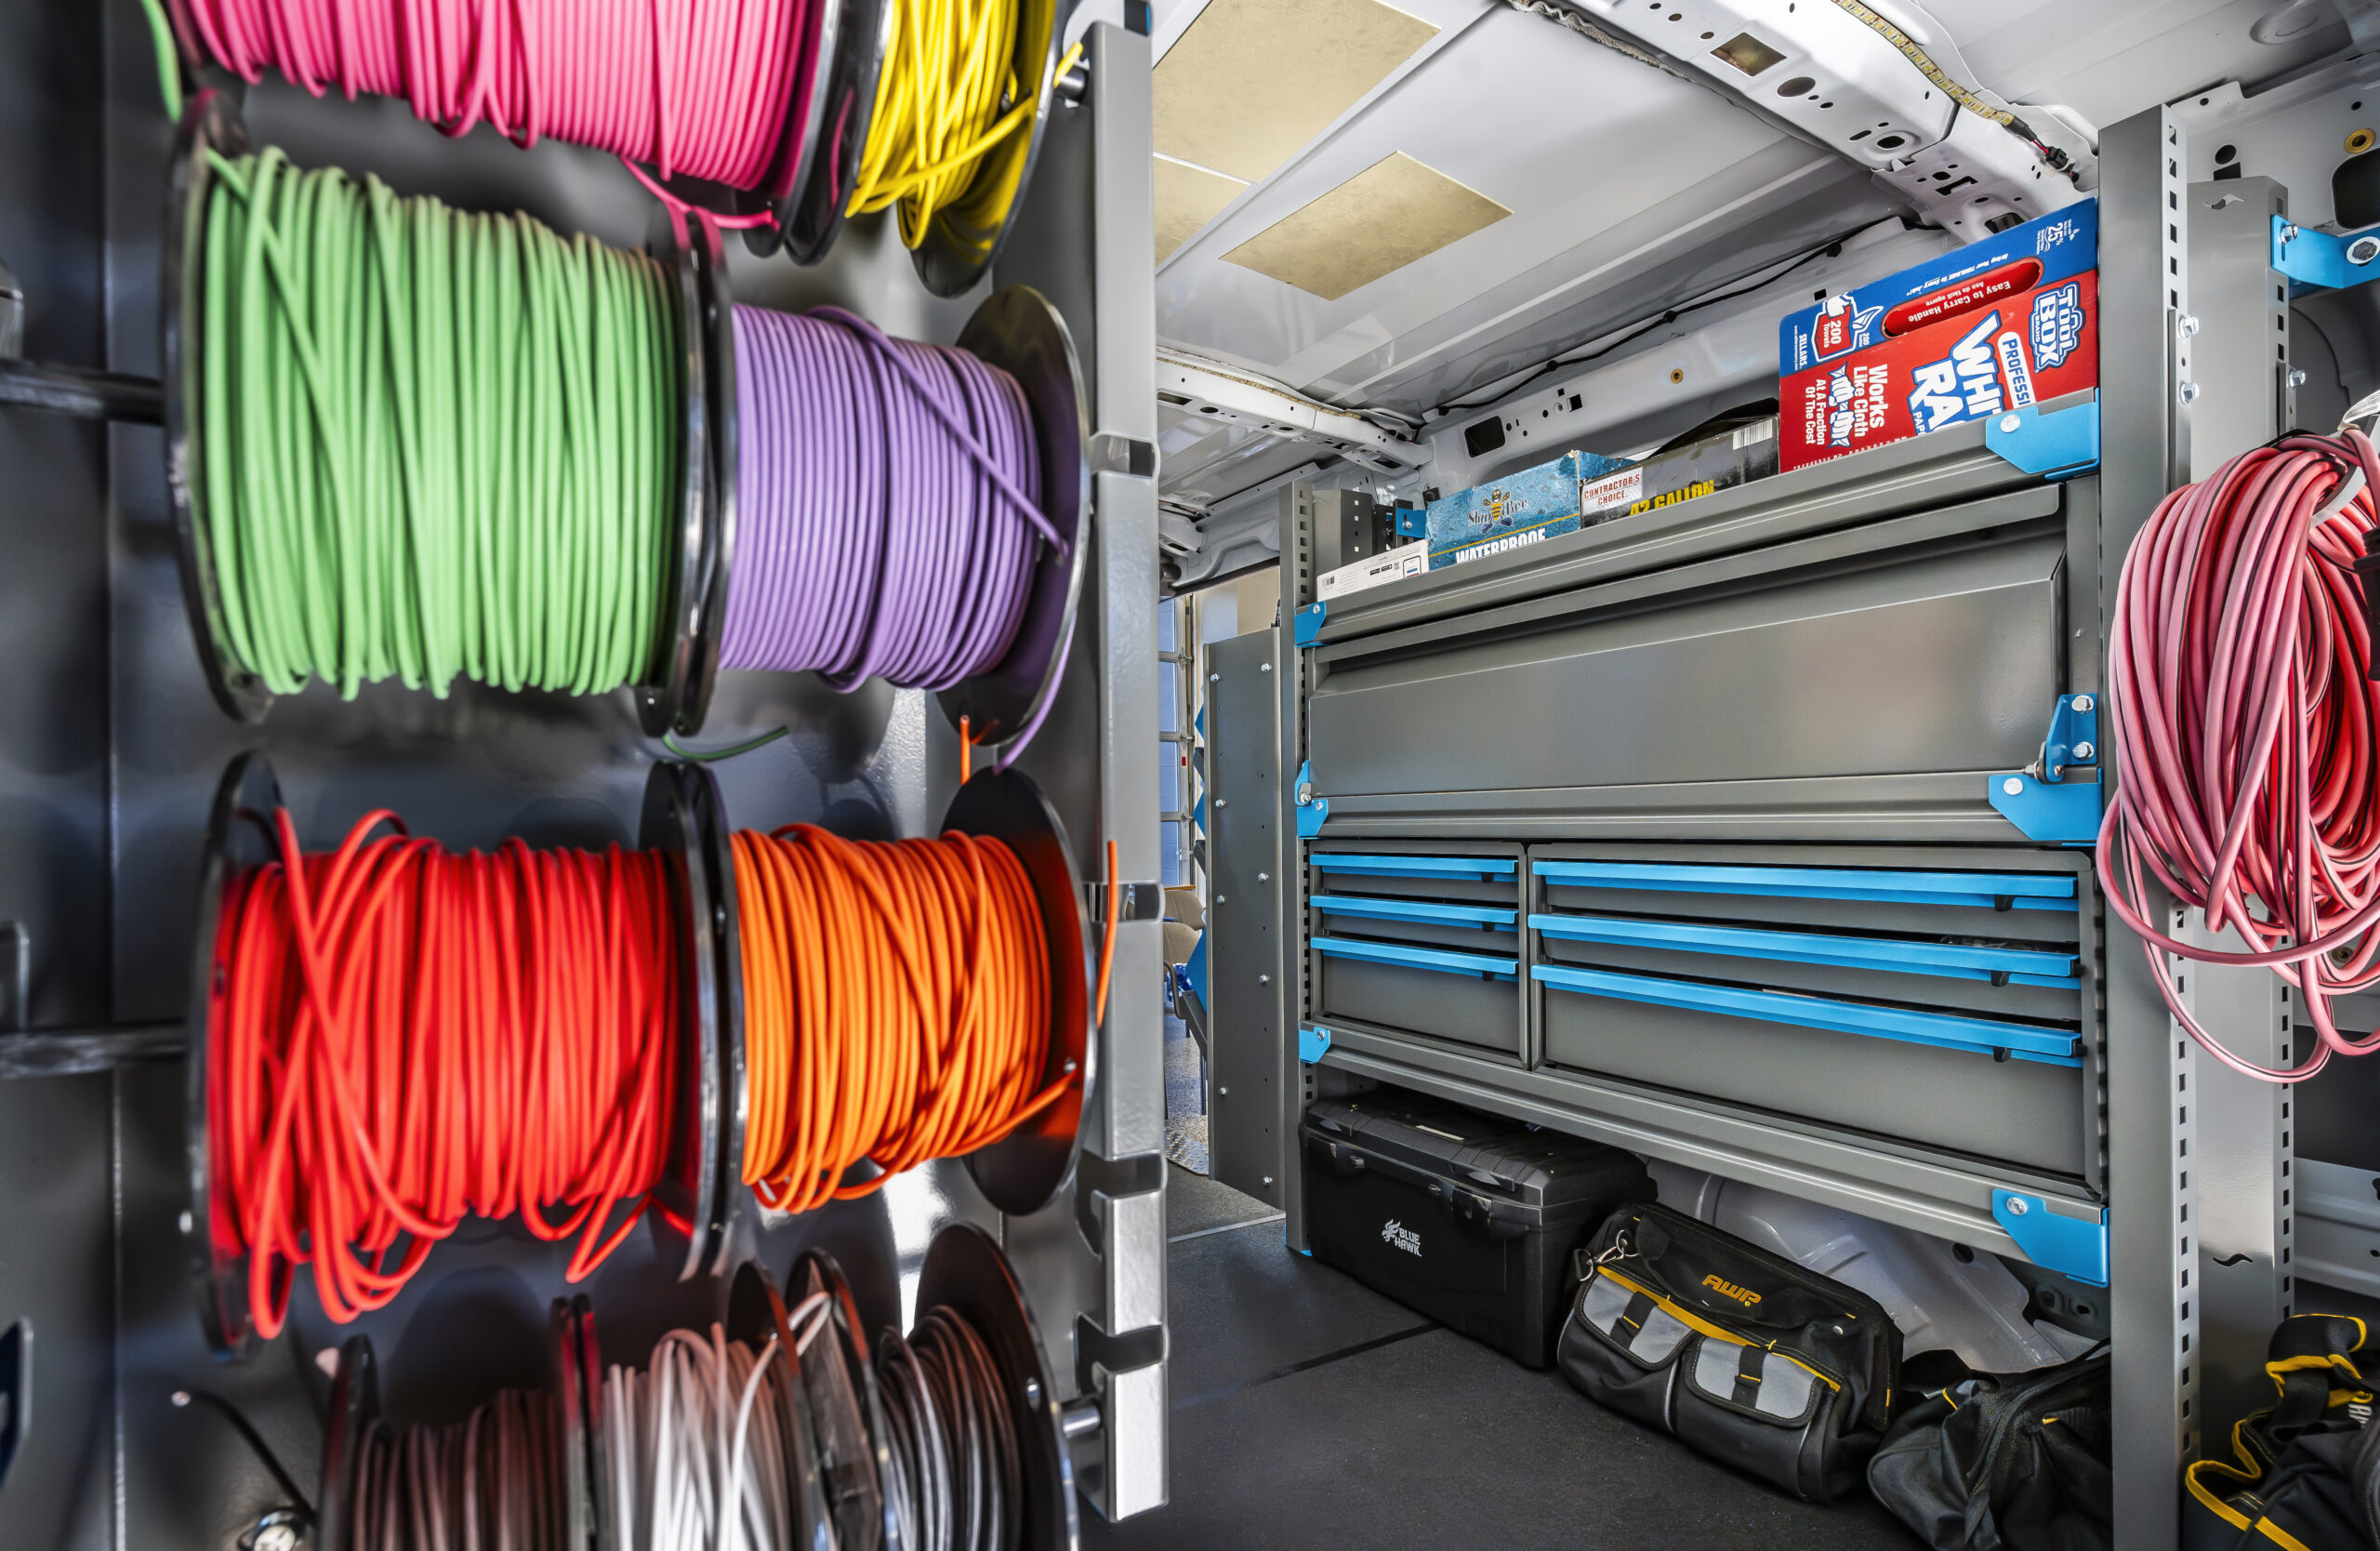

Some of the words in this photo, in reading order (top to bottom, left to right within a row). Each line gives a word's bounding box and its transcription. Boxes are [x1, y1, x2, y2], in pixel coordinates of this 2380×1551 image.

[1973, 290, 1984, 298] to
[1986, 281, 2011, 295] Easy
[1925, 295, 1946, 306] agarre
[1944, 295, 1971, 310] Carry
[1908, 307, 1941, 322] Handle
[2058, 288, 2073, 355] TOOL
[1831, 320, 1842, 344] 200
[2039, 295, 2059, 365] BOX
[1799, 334, 1807, 366] SELLARS
[1952, 313, 2002, 415] WHI
[1805, 387, 1816, 398] Of
[1817, 379, 1826, 391] At
[1854, 365, 1869, 397] Like
[1869, 364, 1888, 429] Works
[1910, 360, 1966, 431] RA
[1805, 400, 1816, 419] The
[1854, 399, 1869, 437] Cloth
[1805, 420, 1816, 444] Cost
[1817, 402, 1827, 445] Fraction
[1584, 473, 1640, 499] CONTRACTOR'S
[1597, 489, 1625, 506] CHOICE
[1395, 1237, 1421, 1256] HAWK
[1398, 1227, 1421, 1246] BLUE
[1702, 1274, 1762, 1304] AWP
